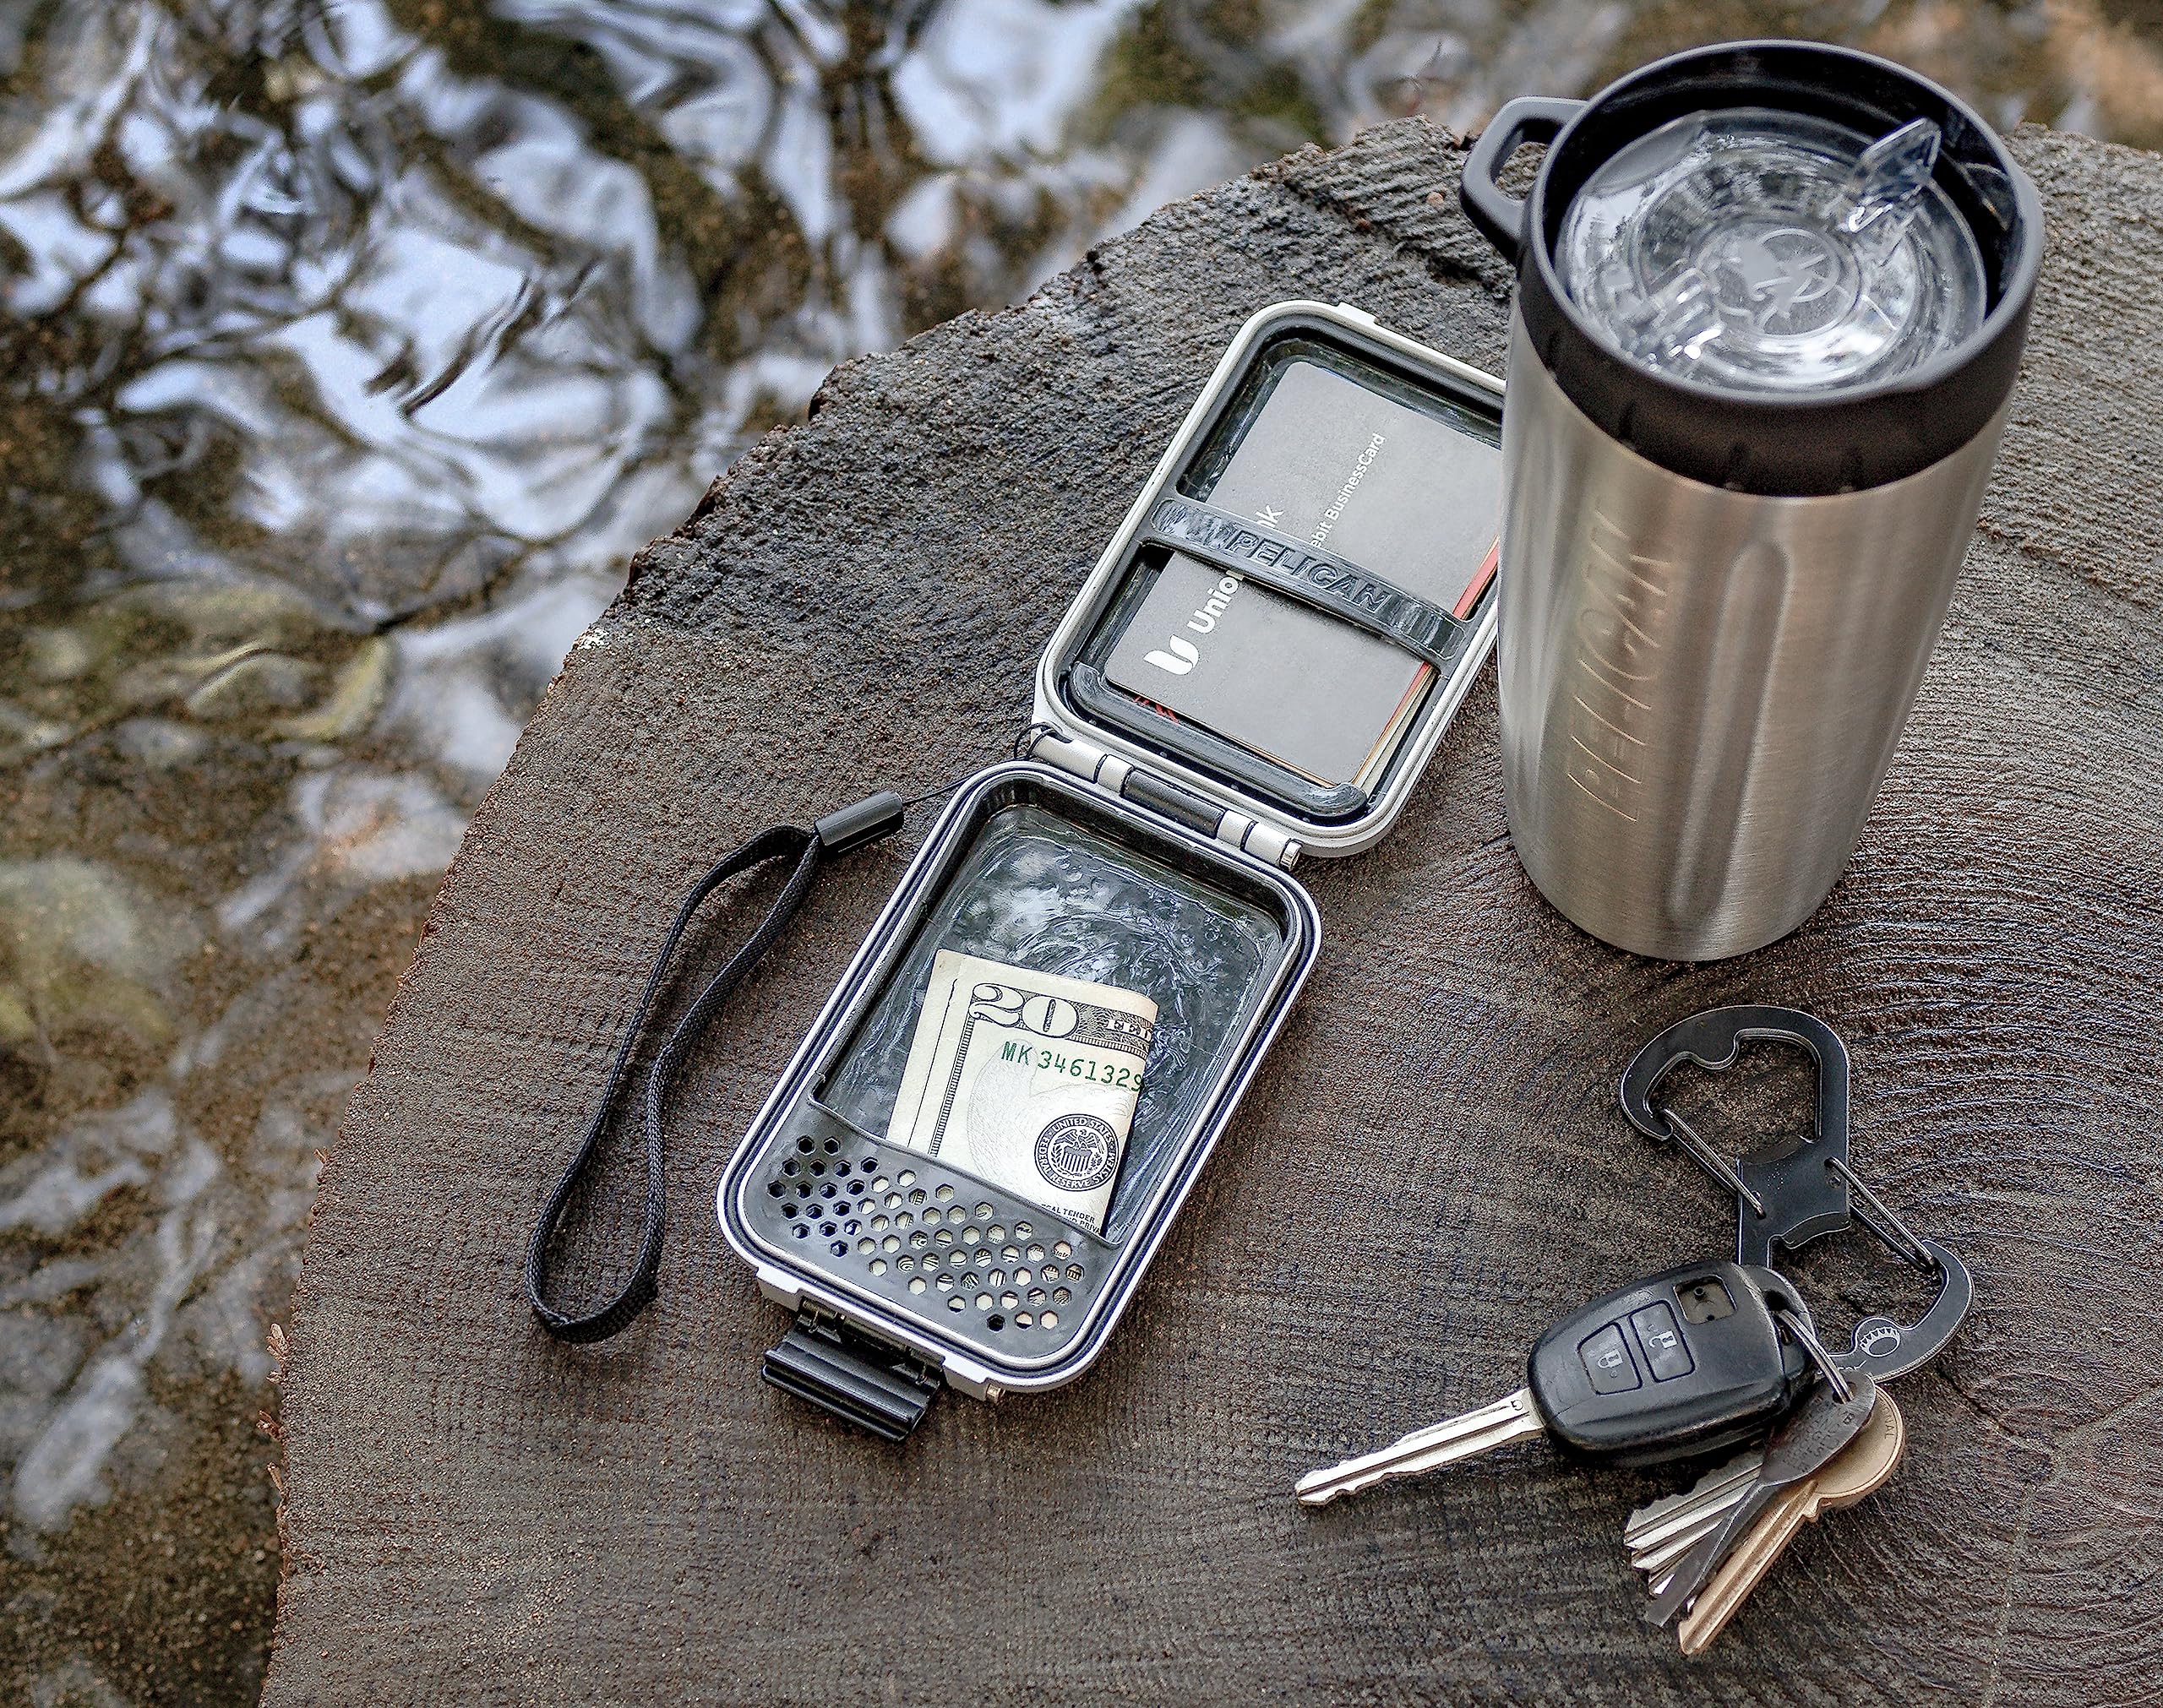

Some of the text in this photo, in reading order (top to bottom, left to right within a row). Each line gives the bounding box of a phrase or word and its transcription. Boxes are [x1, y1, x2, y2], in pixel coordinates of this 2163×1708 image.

[1324, 432, 1387, 521] BusinessCard
[1225, 530, 1392, 613] PELICAN
[1187, 570, 1245, 634] Unio
[1568, 502, 1675, 822] PELICAN
[968, 983, 1079, 1039] 20
[1000, 1041, 1033, 1066] MK
[1054, 1118, 1114, 1141] UNITED STATES
[1038, 1139, 1116, 1189] FEDERAL RESERVE SYSTEM
[1063, 1208, 1095, 1224] TENDER
